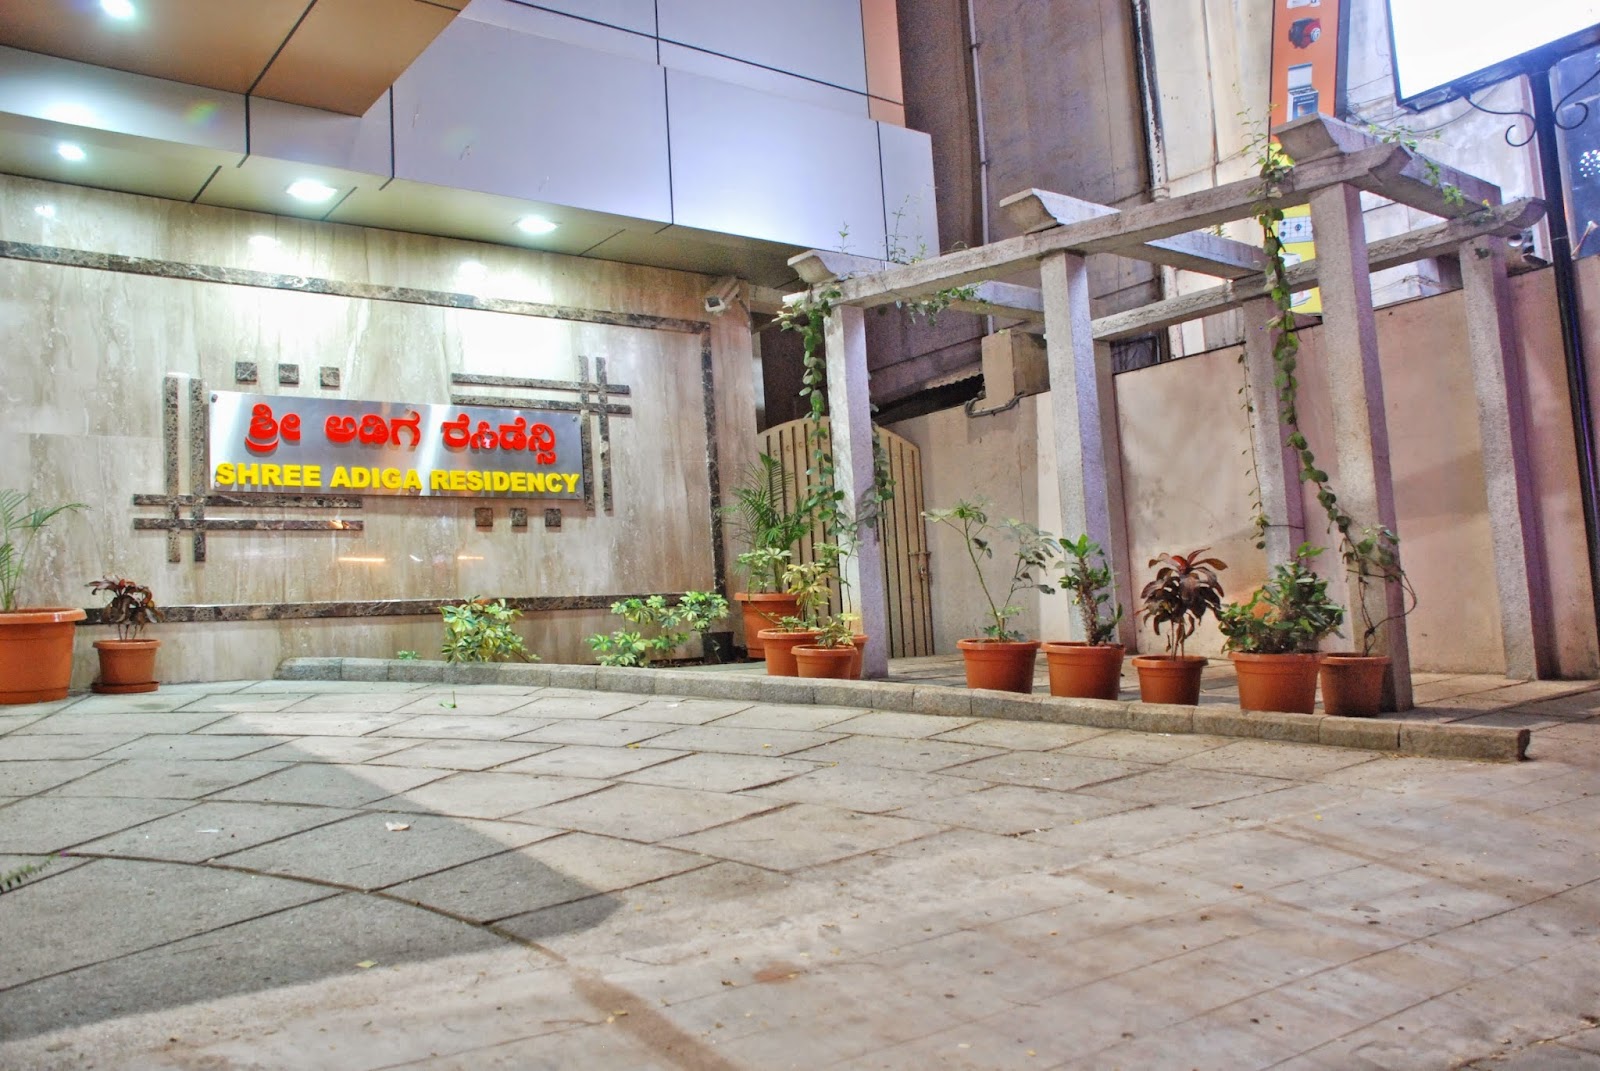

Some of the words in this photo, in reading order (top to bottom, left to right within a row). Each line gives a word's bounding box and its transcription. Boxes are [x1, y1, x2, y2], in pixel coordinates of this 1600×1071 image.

[245, 402, 301, 452] ಶ್ರೀ
[215, 463, 321, 488] SHREE
[330, 466, 422, 490] ADIGA
[431, 470, 580, 493] RESIDENCY
